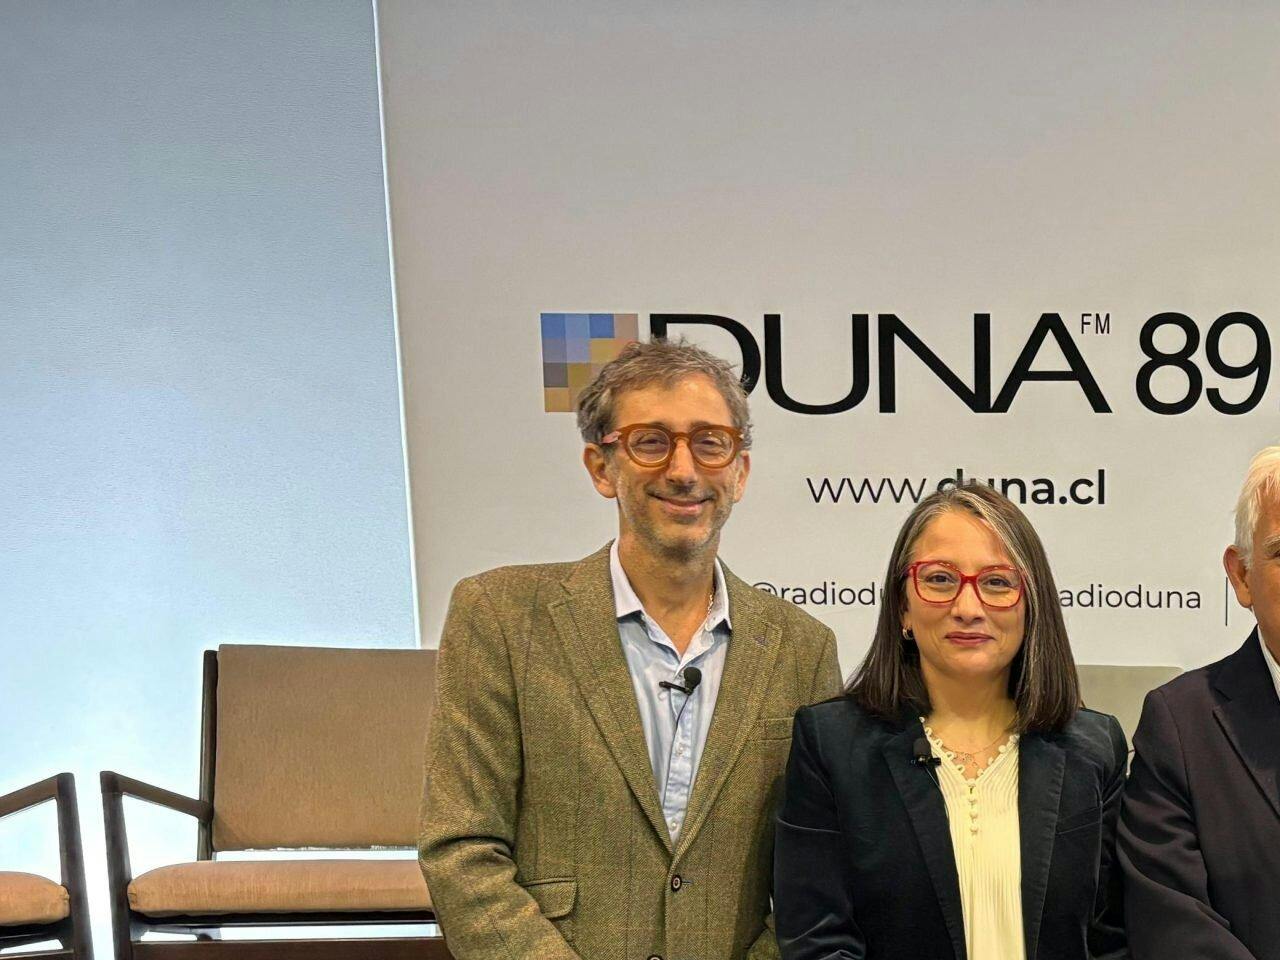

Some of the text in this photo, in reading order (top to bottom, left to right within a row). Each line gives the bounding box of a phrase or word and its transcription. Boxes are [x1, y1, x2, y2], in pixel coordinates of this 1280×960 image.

[650, 313, 1113, 415] DUNA
[1080, 313, 1111, 335] FM
[806, 468, 1105, 505] wwwdna.cl
[753, 581, 885, 606] radiod
[1059, 583, 1201, 609] adioduna
